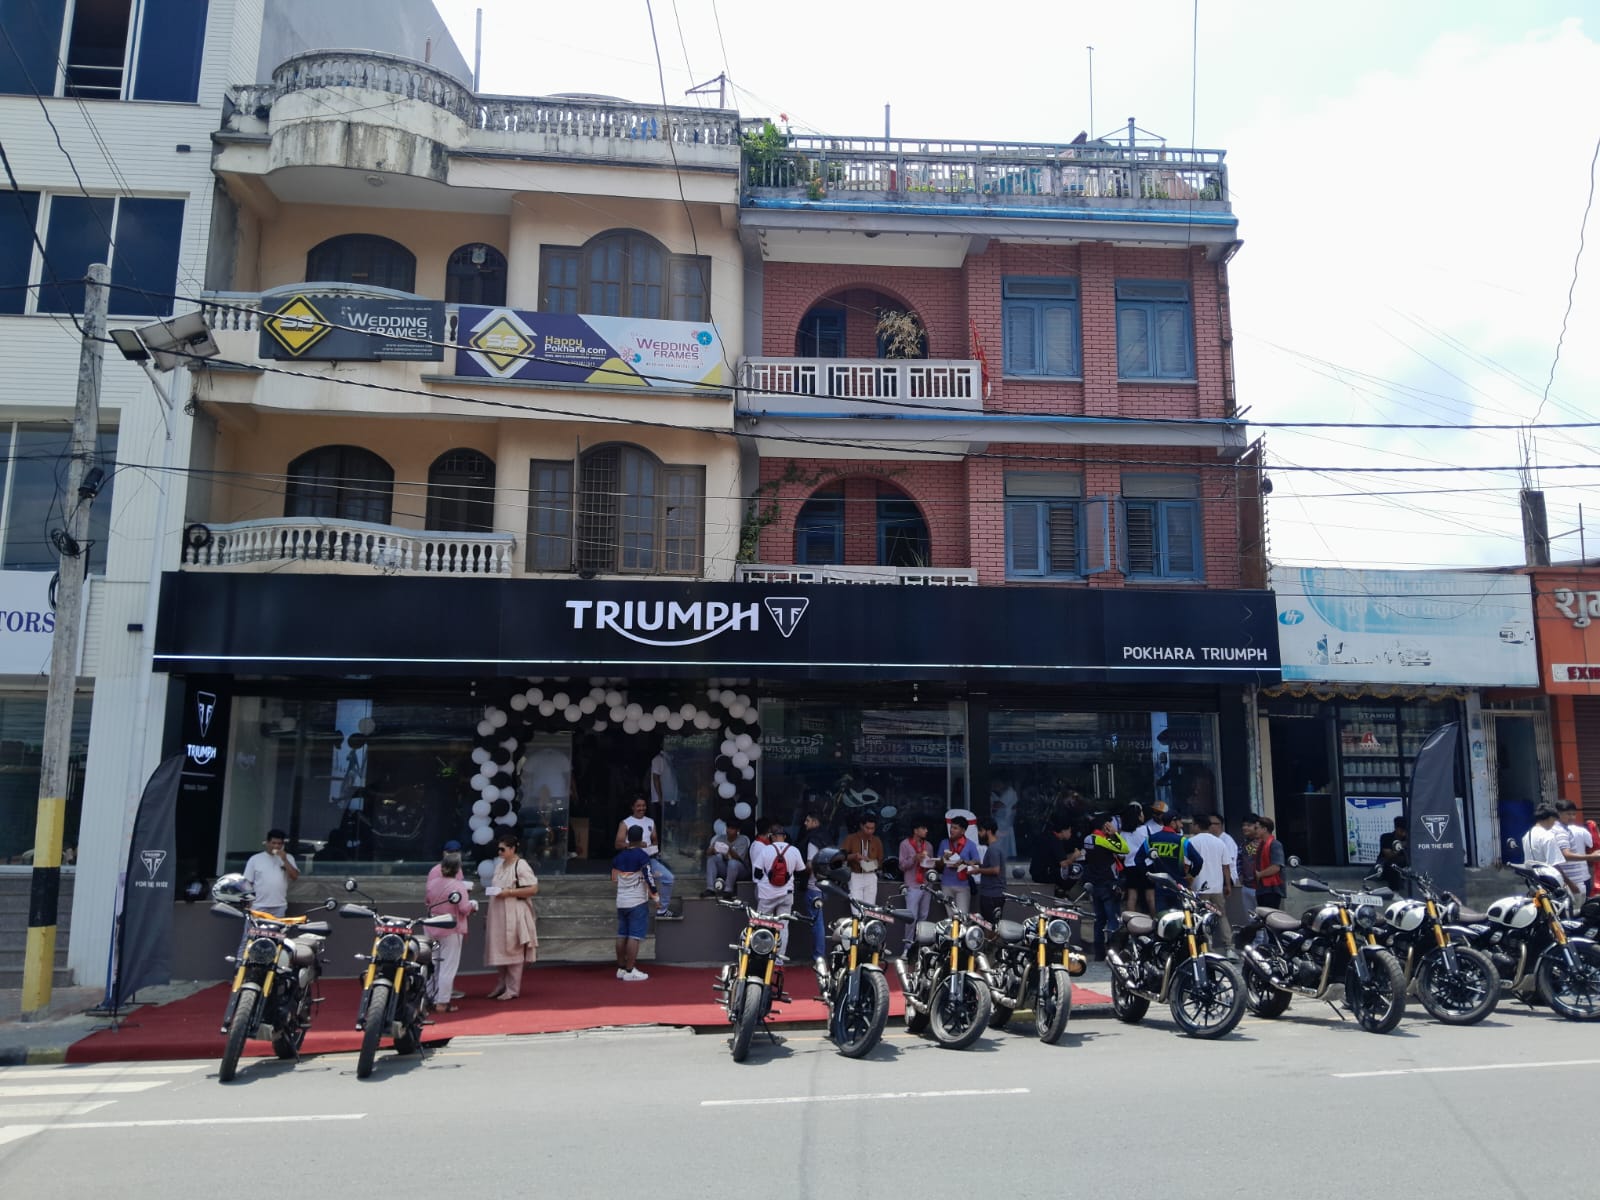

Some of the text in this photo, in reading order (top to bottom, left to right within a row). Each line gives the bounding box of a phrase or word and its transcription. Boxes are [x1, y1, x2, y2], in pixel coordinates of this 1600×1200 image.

[367, 327, 428, 339] FRAMES
[545, 335, 583, 348] Happy
[544, 344, 607, 355] Pokhara.com
[653, 350, 700, 361] FRAMES
[565, 600, 760, 647] TRIUMPH
[1123, 646, 1268, 661] POKHARA TRIUMPH
[187, 744, 217, 765] TRIUMPH
[1151, 842, 1178, 857] FOX
